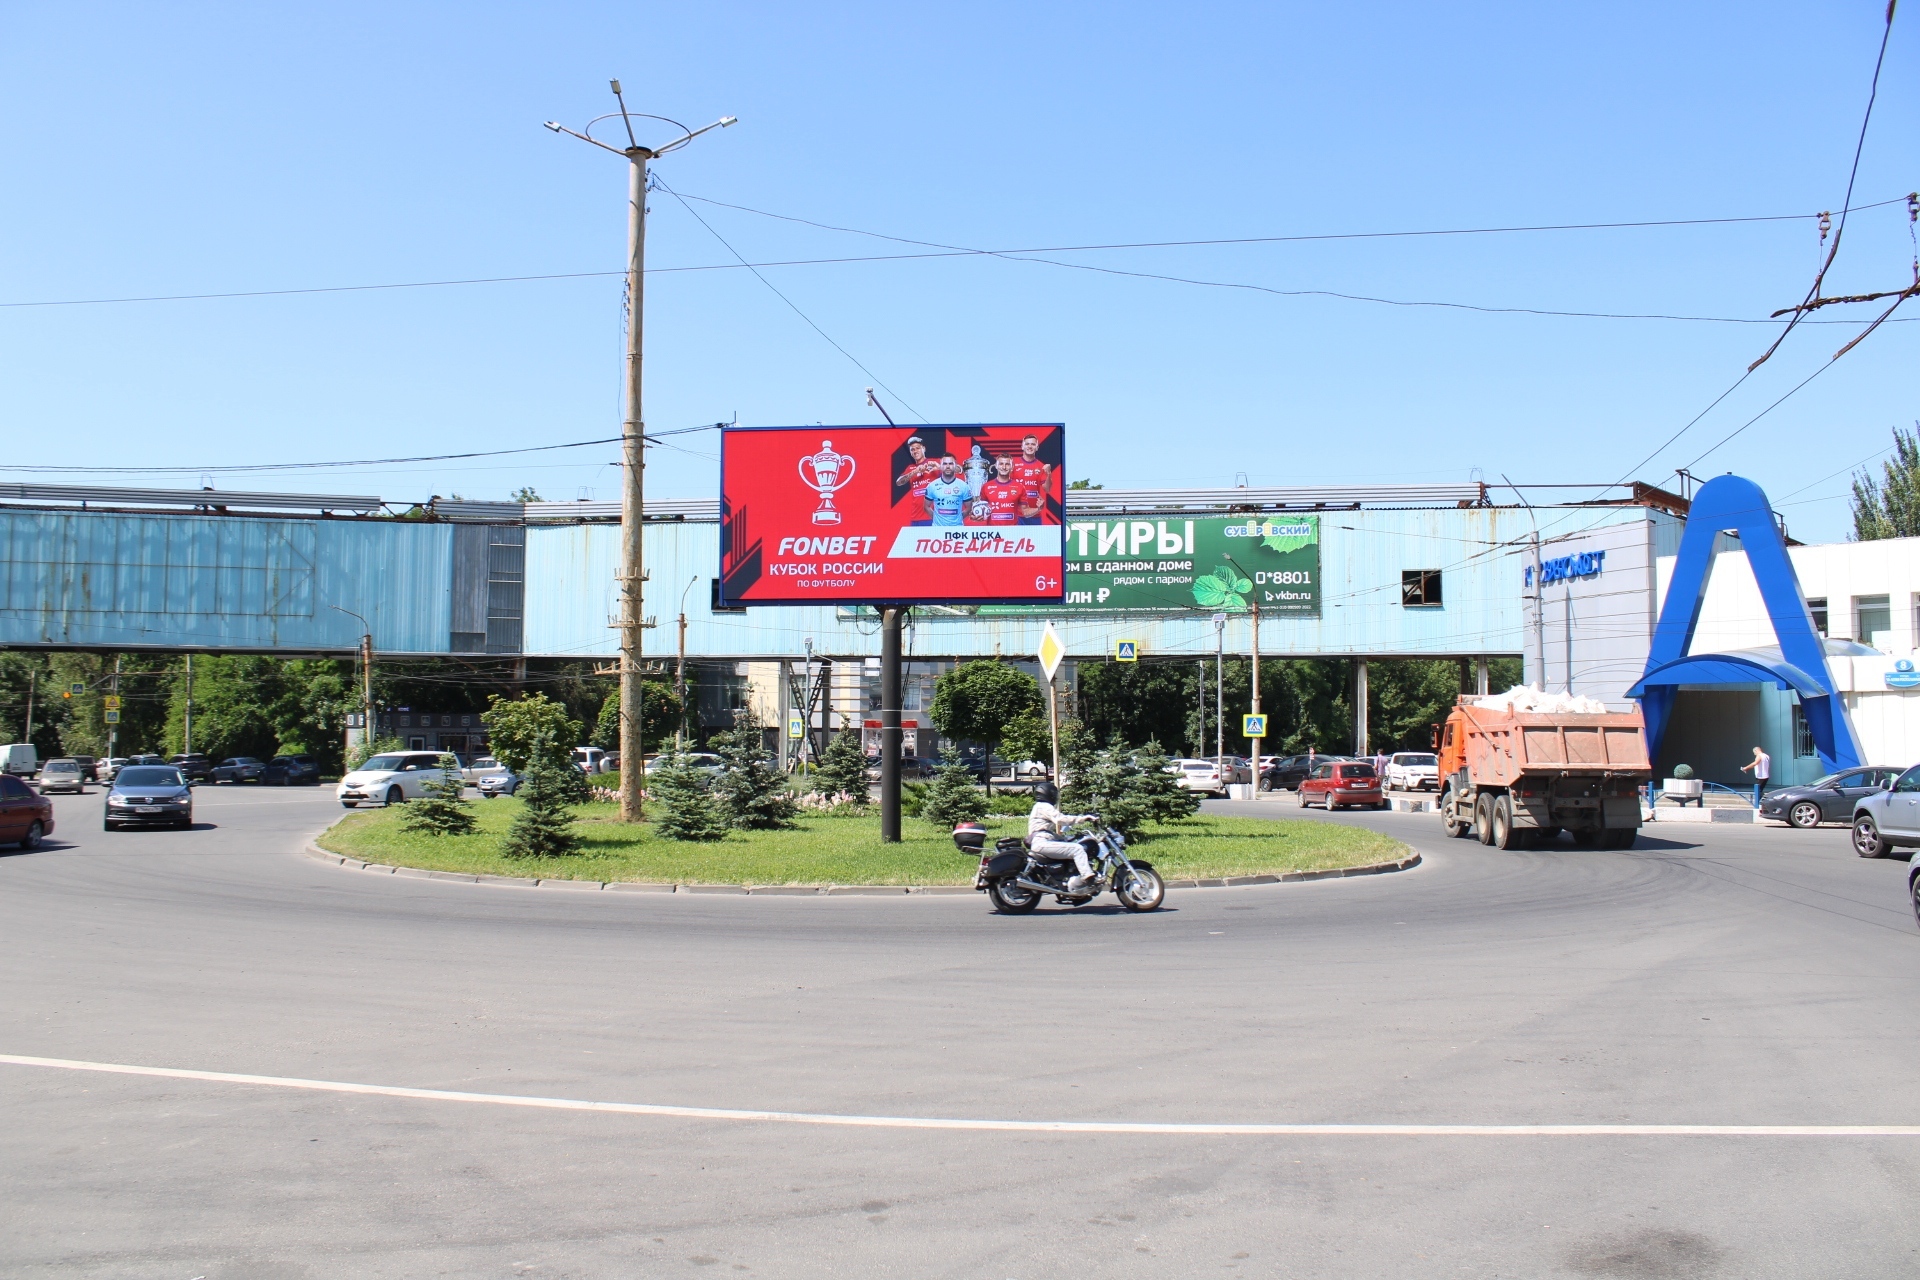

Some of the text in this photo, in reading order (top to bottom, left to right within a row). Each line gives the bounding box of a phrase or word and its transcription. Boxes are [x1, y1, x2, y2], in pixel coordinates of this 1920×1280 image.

[945, 531, 1002, 541] ПФК ЦСКА
[778, 536, 877, 556] FONBET
[915, 538, 1036, 554] ПОБЕДИТЕЛЬ
[769, 562, 883, 576] КУБОК РОССИИ
[1084, 563, 1092, 571] в
[1096, 561, 1154, 573] сданном
[1157, 560, 1192, 573] доме
[811, 579, 856, 587] ФУТБОЛУ
[1035, 575, 1058, 591] 6+
[1113, 575, 1192, 586] рядом с парком
[1275, 591, 1311, 600] vkbn.ru
